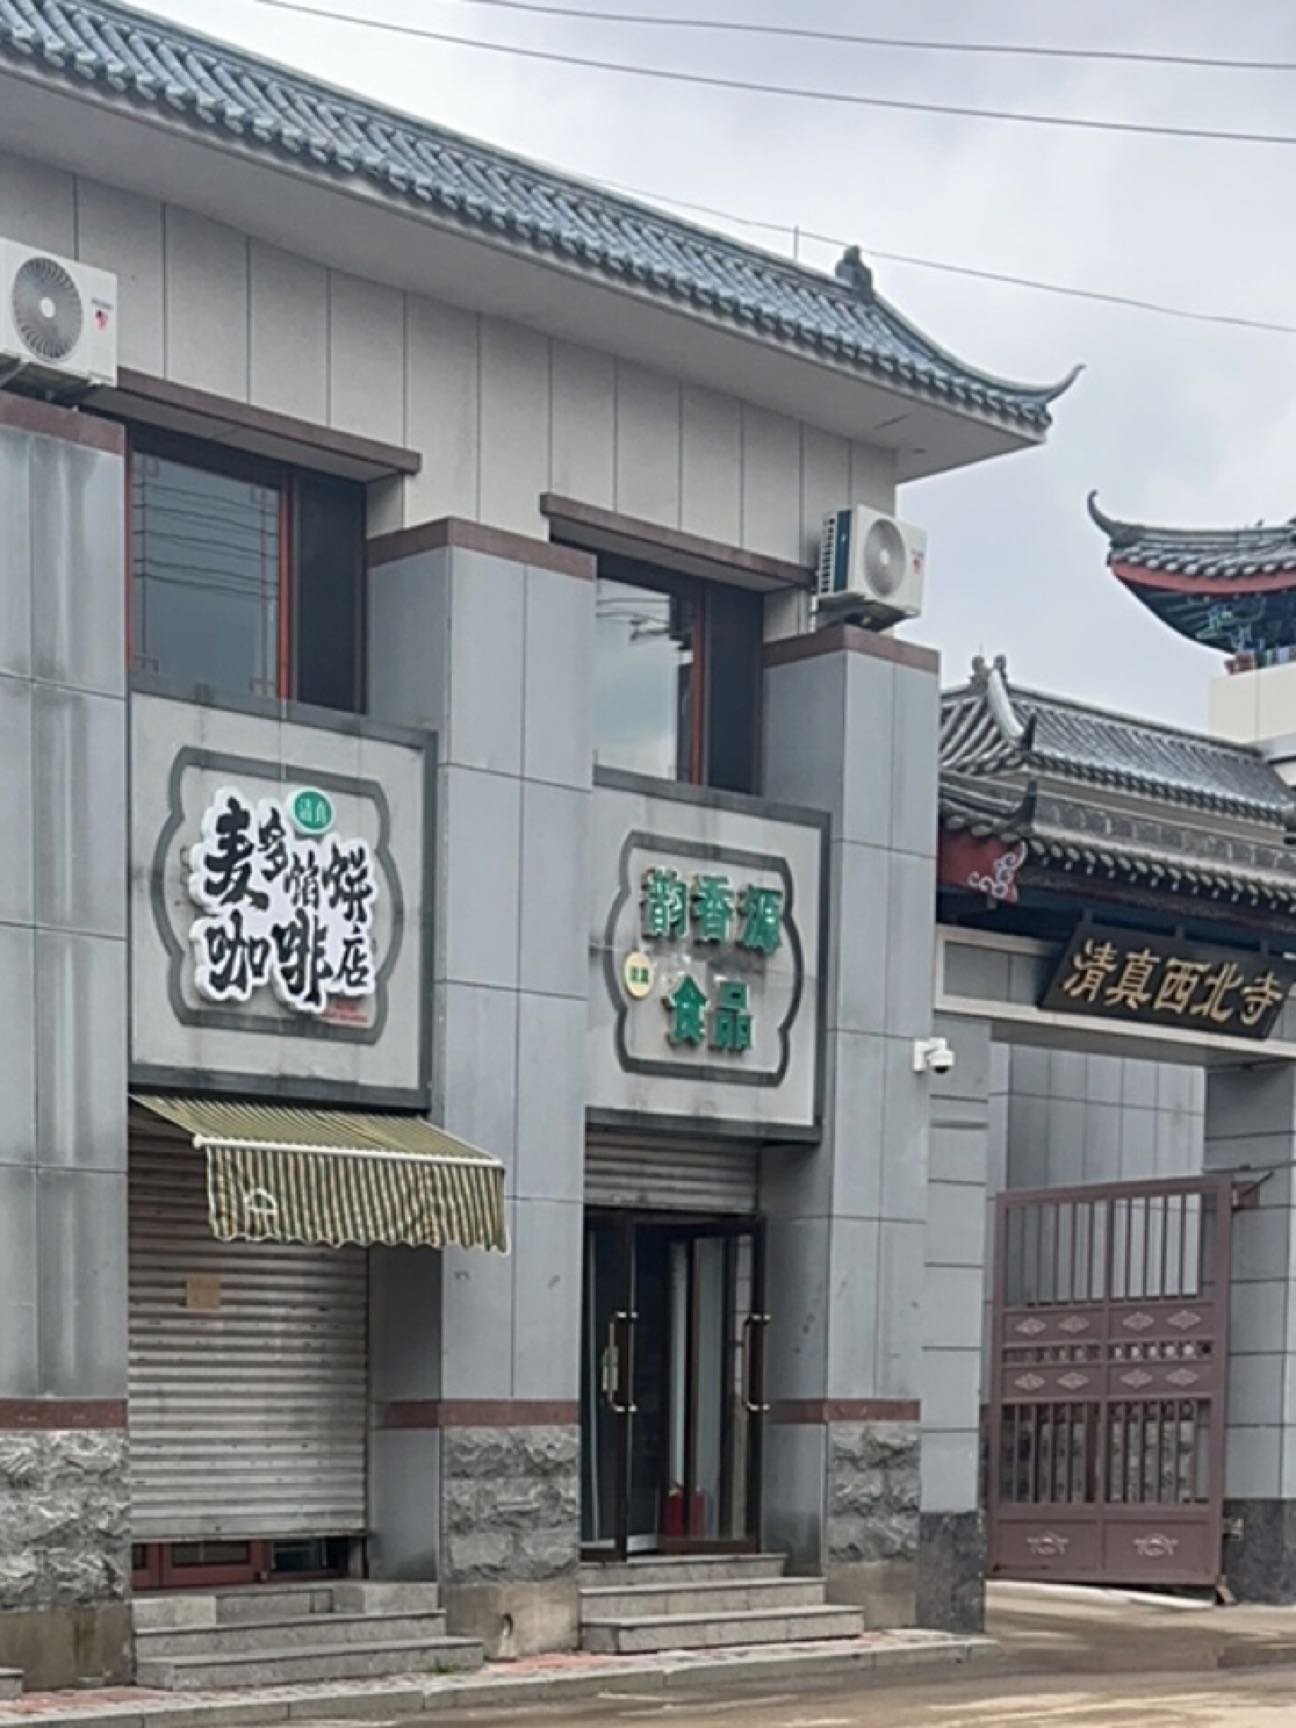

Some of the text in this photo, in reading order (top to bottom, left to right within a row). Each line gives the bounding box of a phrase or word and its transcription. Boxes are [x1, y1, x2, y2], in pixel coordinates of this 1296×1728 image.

[205, 908, 368, 1007] 咖啡店
[1062, 938, 1283, 1026] 清真西北寺
[662, 974, 751, 1050] 食品
